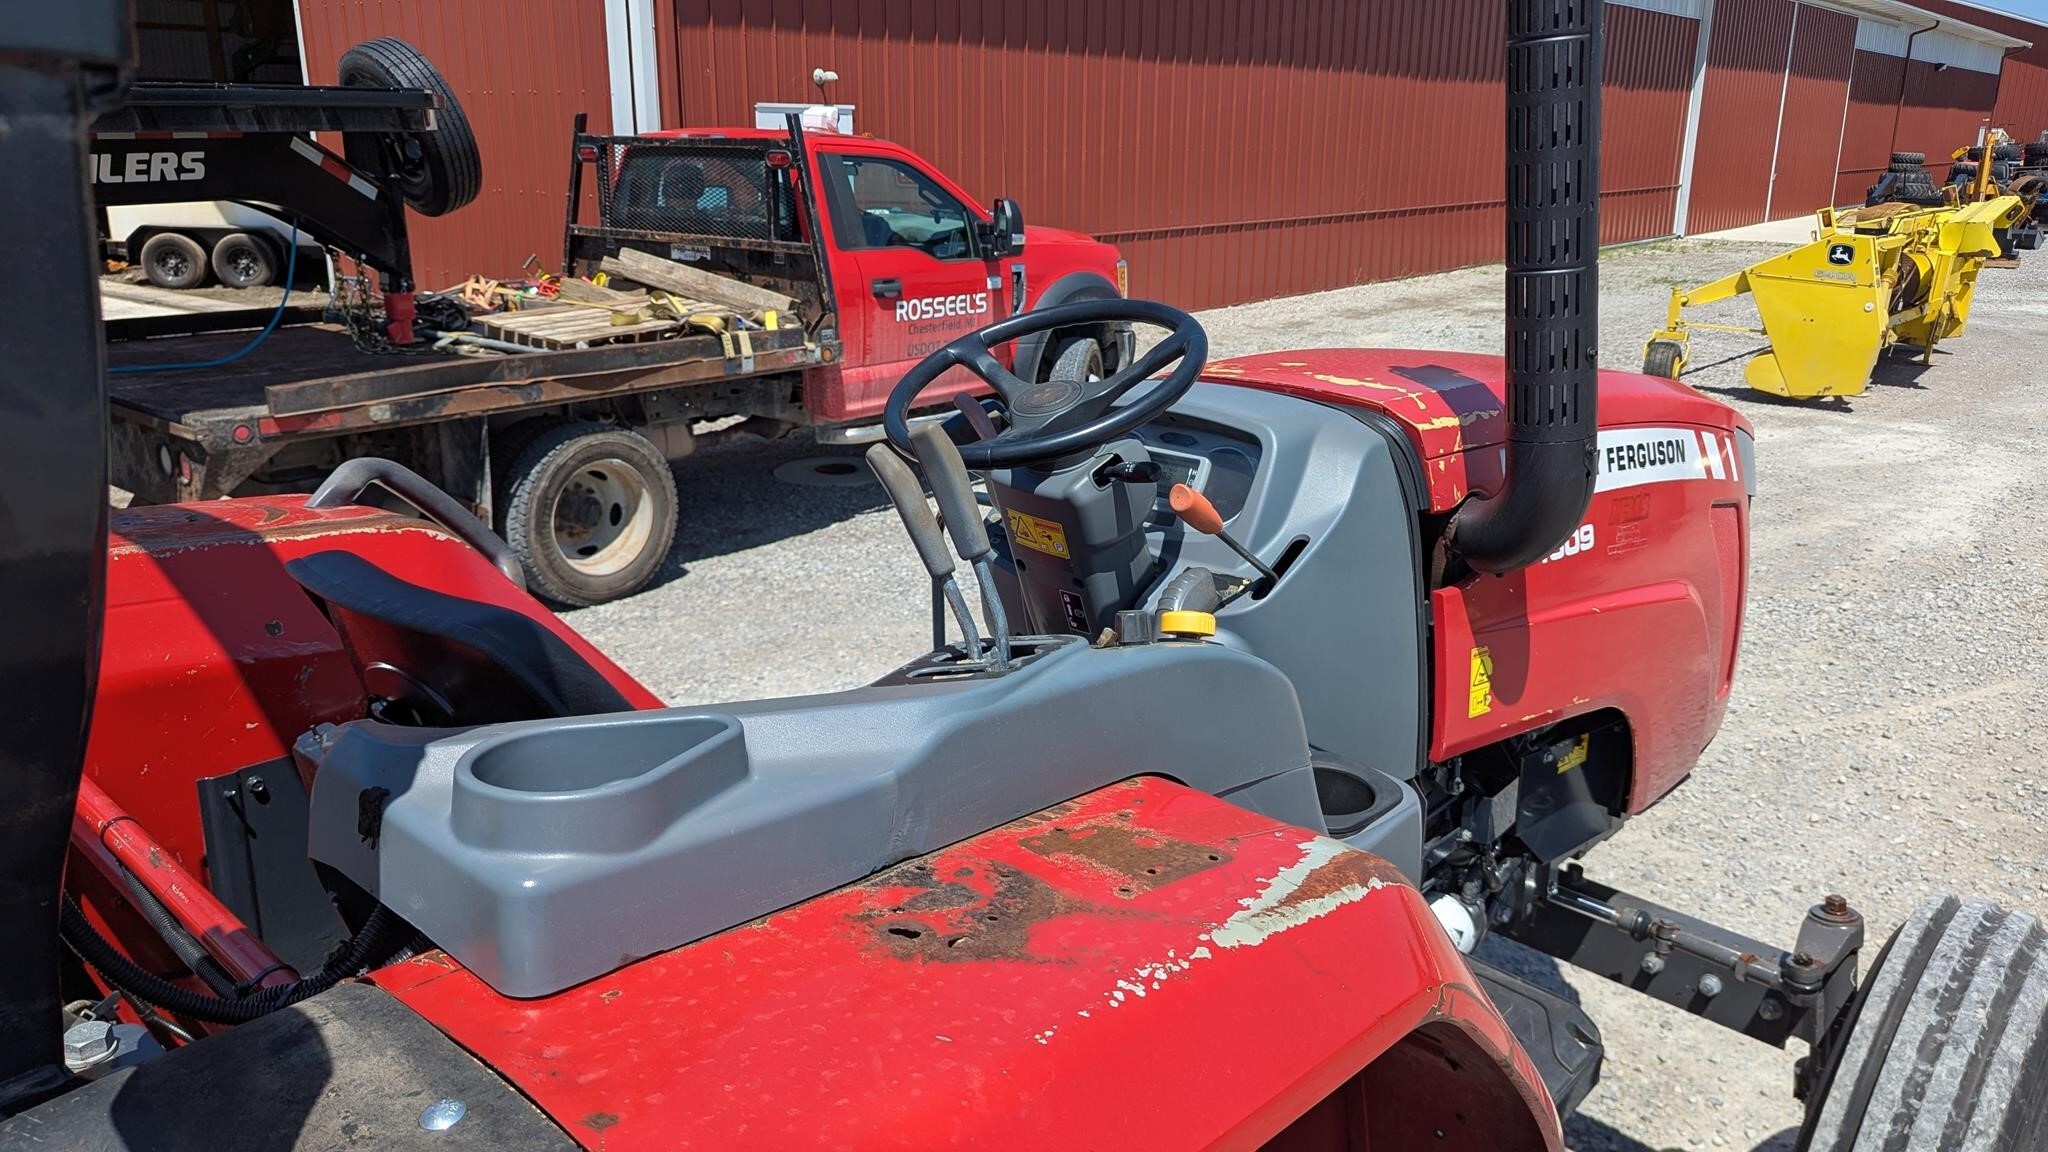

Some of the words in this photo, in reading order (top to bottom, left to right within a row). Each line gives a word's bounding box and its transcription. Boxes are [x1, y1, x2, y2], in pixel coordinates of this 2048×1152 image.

[896, 293, 987, 322] ROSSEEL'S
[1606, 439, 1686, 473] FERGUSON
[1541, 523, 1595, 564] 09
